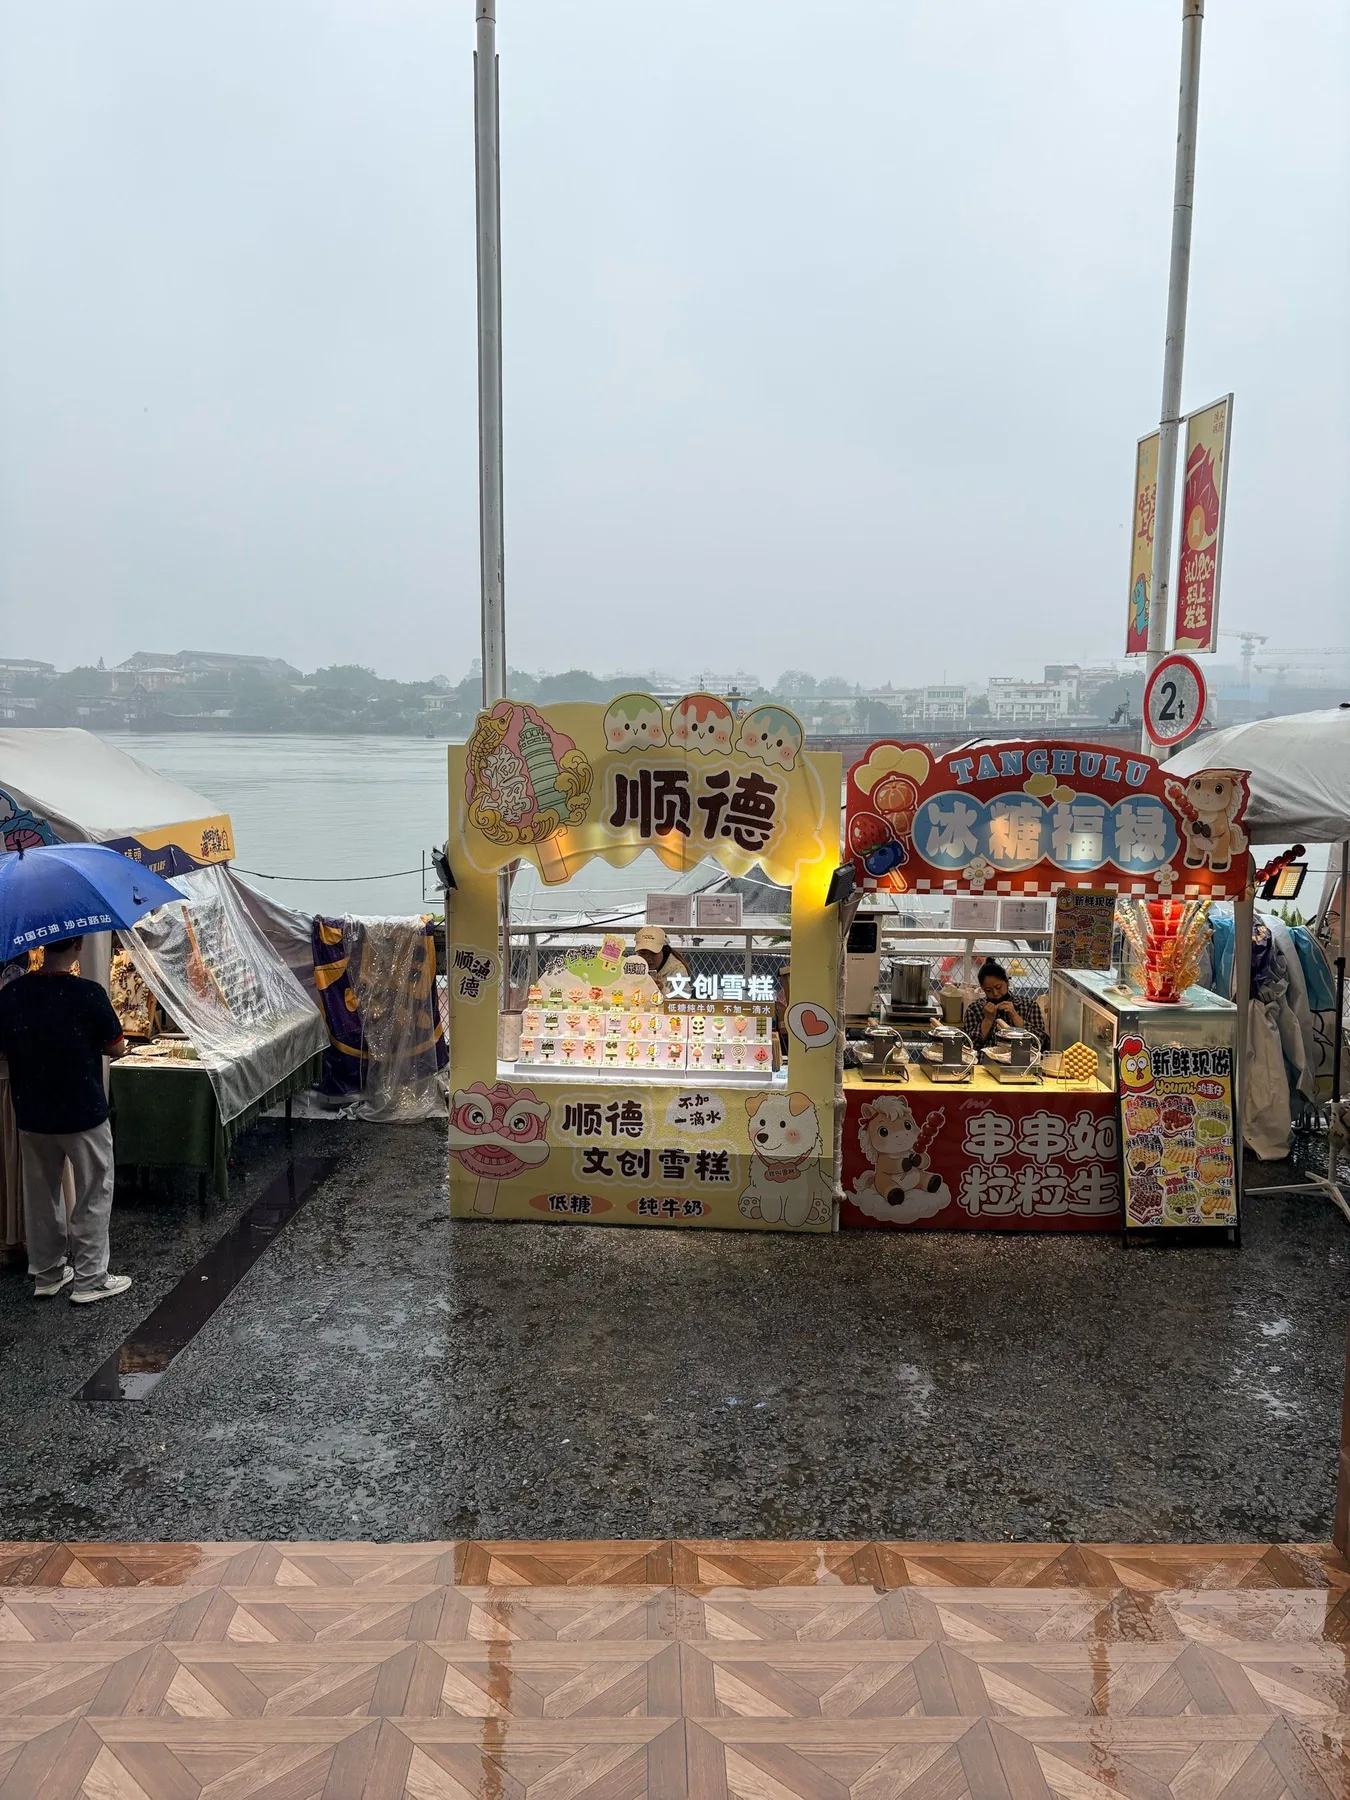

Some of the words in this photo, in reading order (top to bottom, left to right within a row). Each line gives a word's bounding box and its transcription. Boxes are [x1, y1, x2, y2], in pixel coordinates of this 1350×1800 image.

[1183, 604, 1208, 629] 发生
[1159, 682, 1185, 721] 2t
[950, 748, 1151, 787] TANGHULU
[609, 769, 778, 851] 顺德
[925, 801, 1167, 862] 冰糖福禄
[13, 924, 60, 945] 中国石油
[64, 914, 112, 930] 沙古路站
[624, 962, 647, 975] 低糖
[666, 973, 774, 1001] 文创雪糕
[668, 1004, 716, 1014] 低糖纯牛奶
[723, 1005, 771, 1015] 不加一滴水
[678, 1094, 709, 1109] 不加
[1198, 1083, 1223, 1096] 鸡蛋仔
[562, 1100, 644, 1138] 顺德
[674, 1111, 721, 1127] 一滴水
[963, 1111, 1117, 1164] 串串如
[582, 1147, 731, 1182] 文创雪糕
[549, 1194, 592, 1214] 低糖
[961, 1166, 1120, 1214] 粒粒生
[639, 1198, 704, 1217] 纯牛奶
